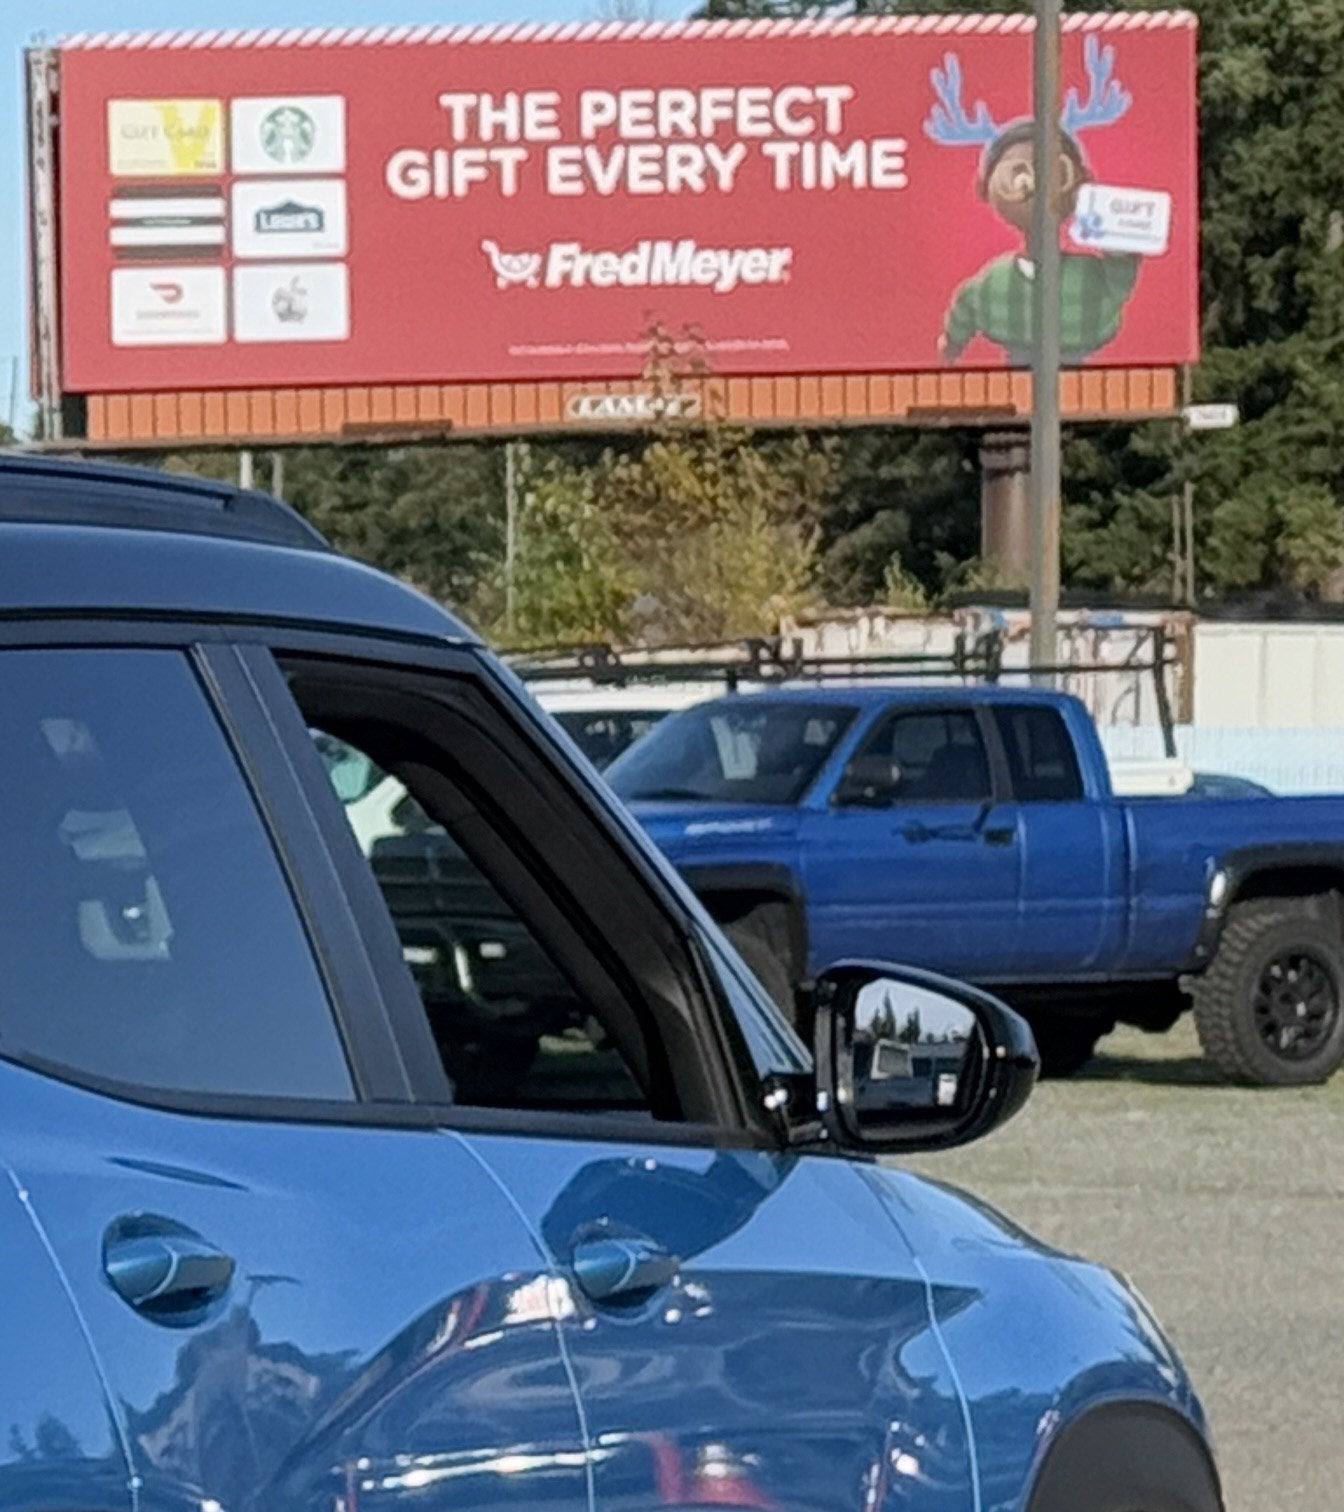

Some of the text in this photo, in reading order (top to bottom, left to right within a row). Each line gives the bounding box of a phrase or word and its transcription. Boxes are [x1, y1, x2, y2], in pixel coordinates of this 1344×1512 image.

[438, 85, 855, 142] THE PERFECT
[385, 137, 910, 200] GIFT EVERY TIME
